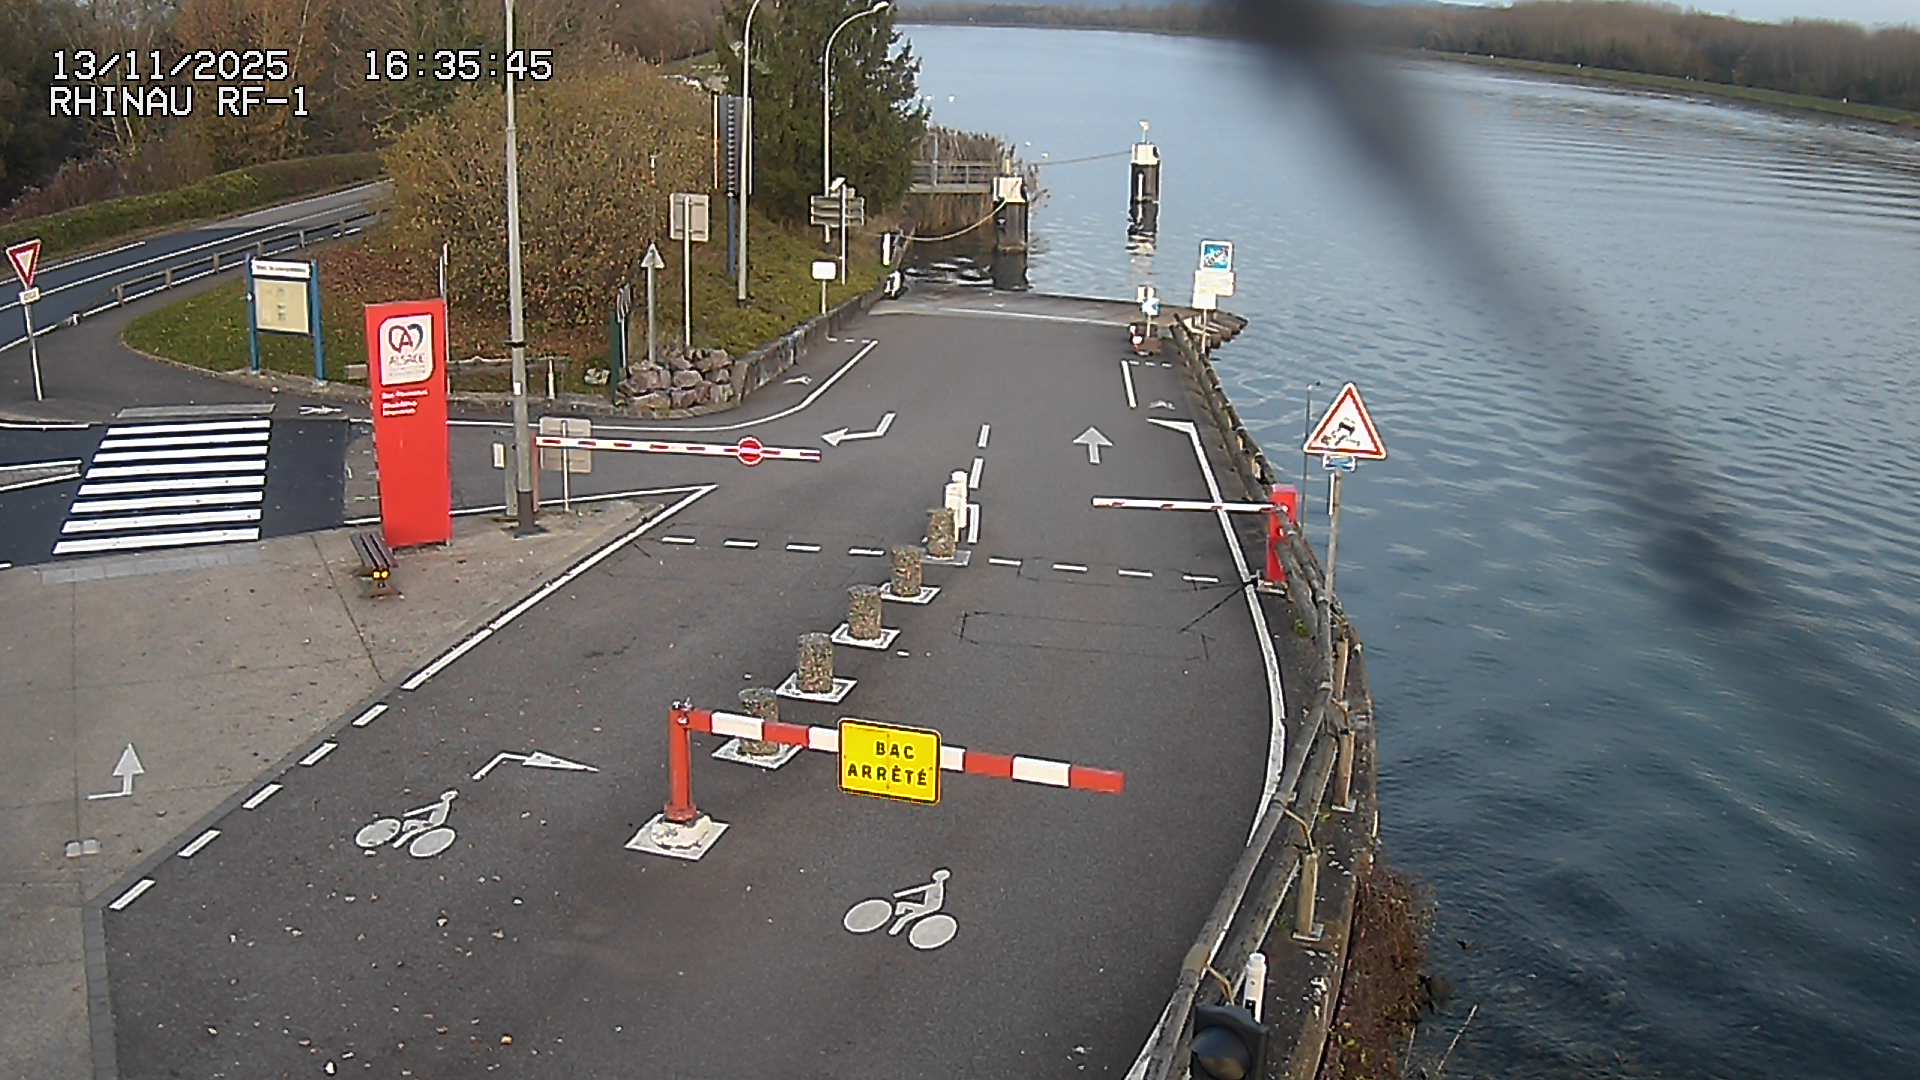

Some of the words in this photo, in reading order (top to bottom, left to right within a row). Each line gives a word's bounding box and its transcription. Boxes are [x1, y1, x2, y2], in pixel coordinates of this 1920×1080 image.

[389, 353, 425, 365] ALSACE
[876, 741, 914, 759] BAC
[847, 763, 927, 786] ARRÊTÉ
